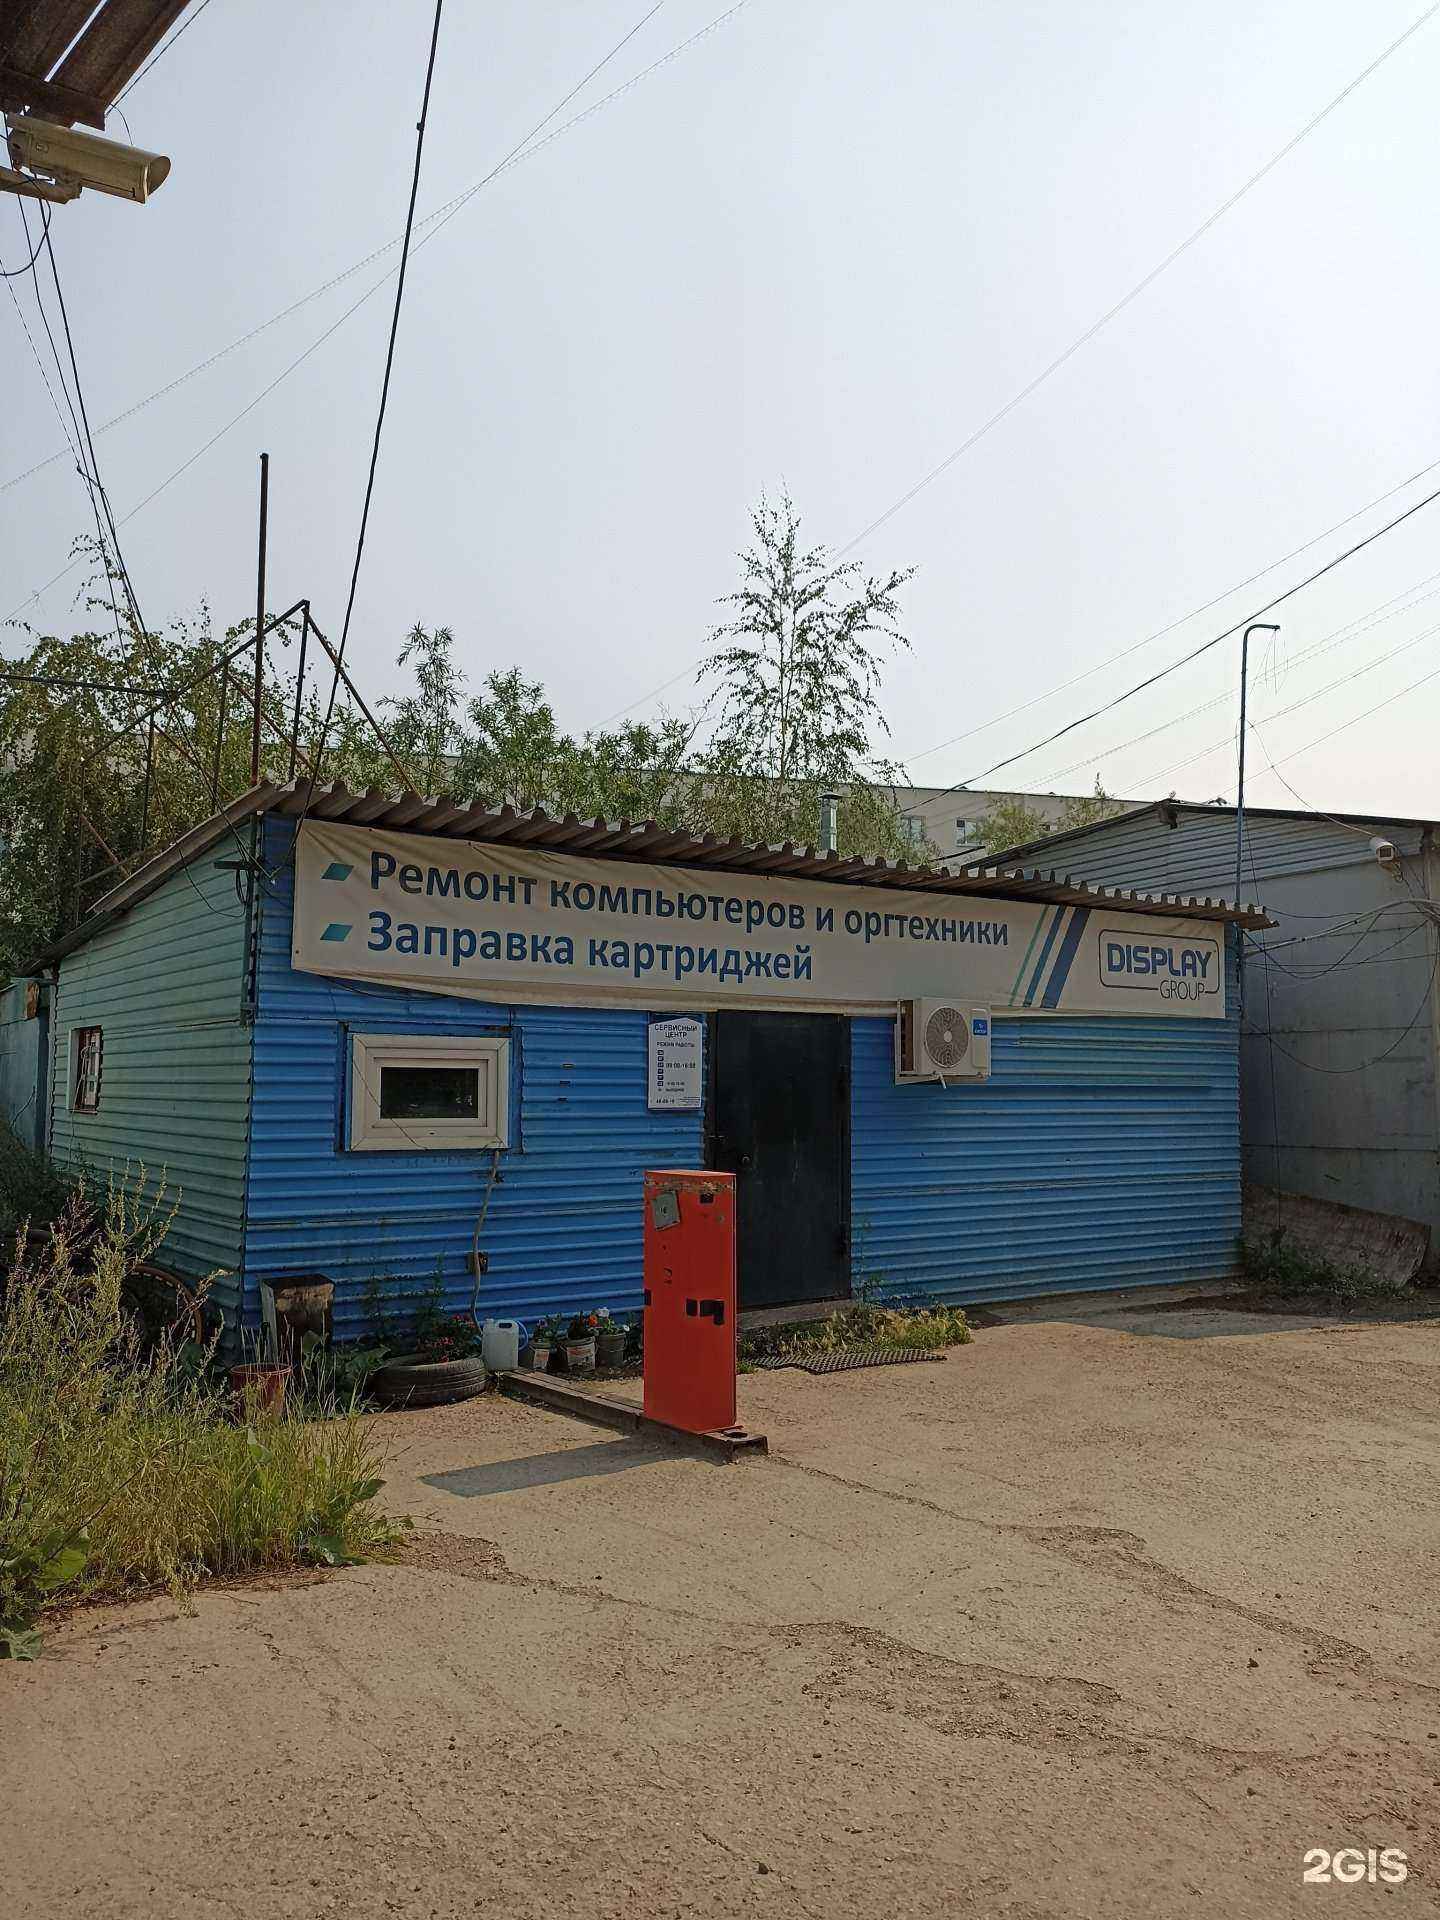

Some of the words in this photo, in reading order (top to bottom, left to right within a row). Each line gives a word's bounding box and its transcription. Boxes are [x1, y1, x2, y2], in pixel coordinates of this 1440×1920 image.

[370, 850, 538, 905] Ремонт
[550, 879, 805, 933] компьютеров
[815, 906, 835, 933] и
[844, 909, 1009, 946] оргтехники
[367, 910, 574, 967] Заправка
[588, 937, 812, 984] картриджей
[1106, 942, 1212, 979] DISPLAY
[1159, 980, 1206, 1001] GROUP
[654, 1023, 698, 1032] СЕРВИСНЫЙ
[664, 1031, 688, 1039] ЦЕНТР
